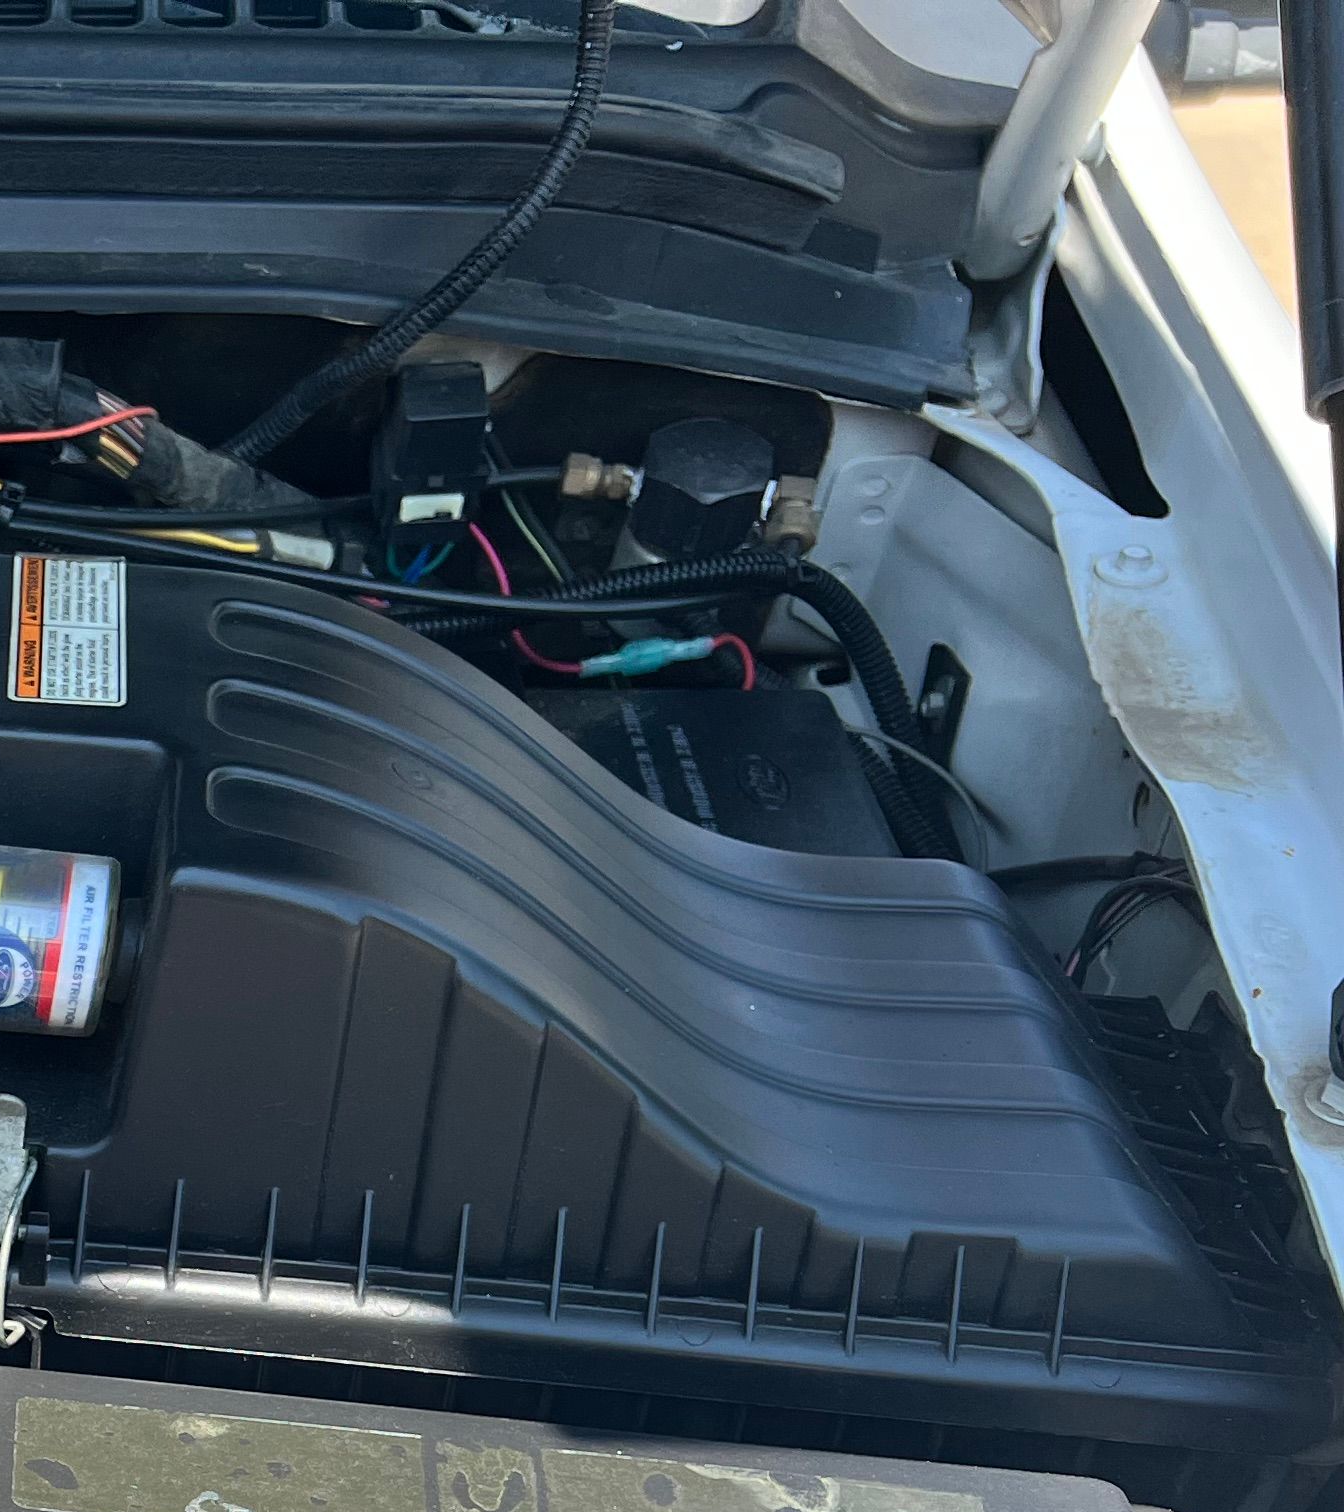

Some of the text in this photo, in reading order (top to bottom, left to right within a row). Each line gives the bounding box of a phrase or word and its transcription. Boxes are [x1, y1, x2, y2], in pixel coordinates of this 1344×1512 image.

[24, 640, 36, 678] WARNING
[83, 885, 96, 904] AIR
[76, 907, 94, 952] FILTER
[14, 961, 34, 999] POWER
